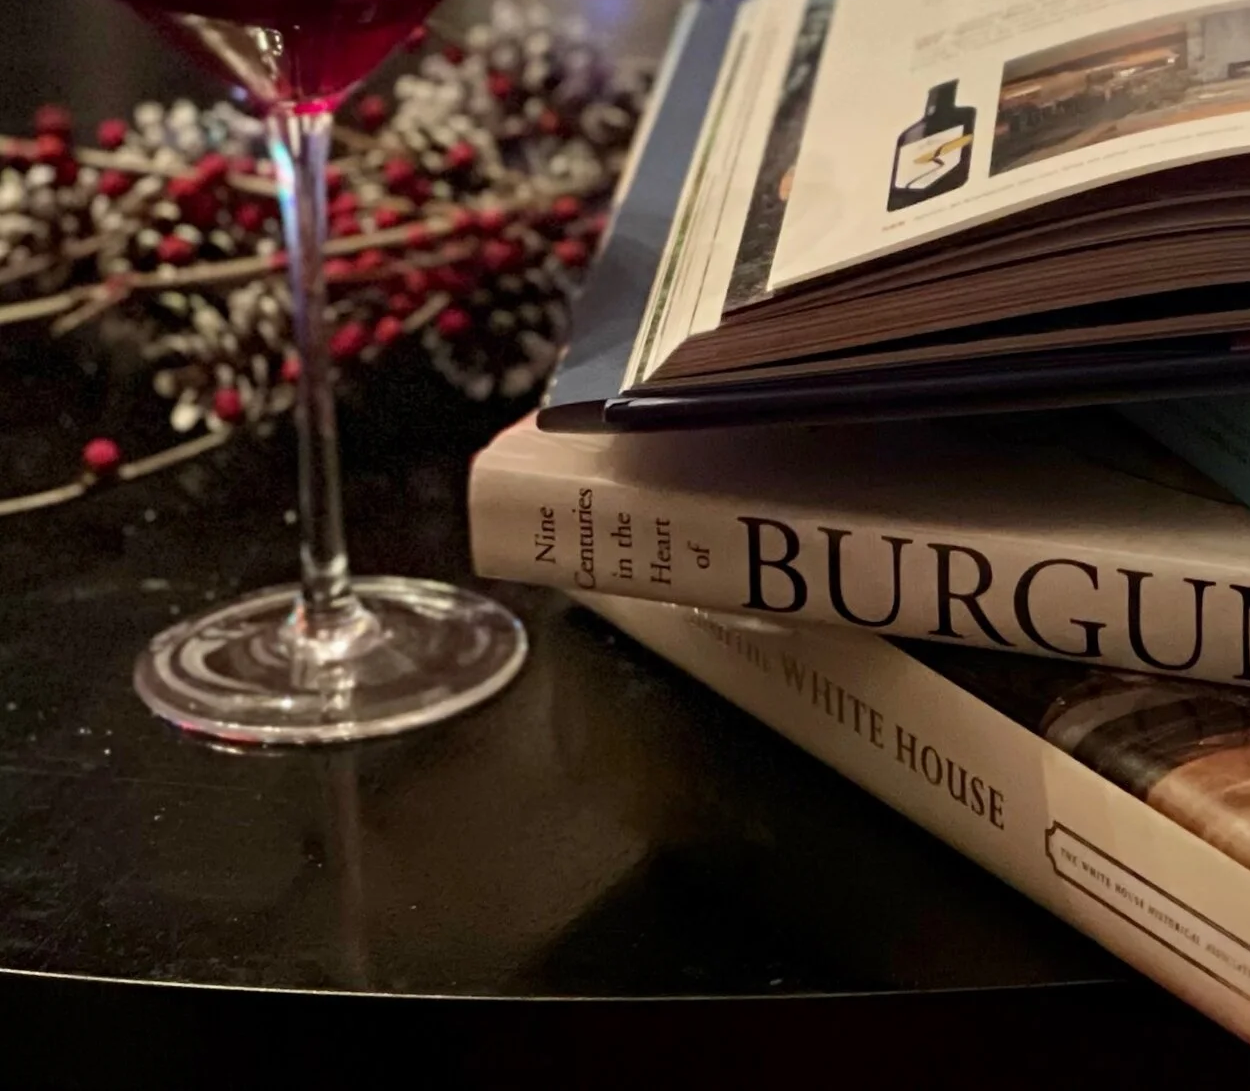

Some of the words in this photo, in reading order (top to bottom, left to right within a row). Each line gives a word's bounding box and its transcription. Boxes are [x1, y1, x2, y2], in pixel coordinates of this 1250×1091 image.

[535, 506, 556, 564] Nine
[574, 488, 596, 590] Centuries
[611, 512, 633, 548] the
[651, 517, 672, 586] Heart
[688, 540, 711, 570] of
[612, 559, 633, 580] in
[781, 651, 884, 750] WHITE
[896, 723, 1005, 831] HOUSE
[1081, 861, 1111, 890] WHITE
[1114, 884, 1145, 910] HOUSE
